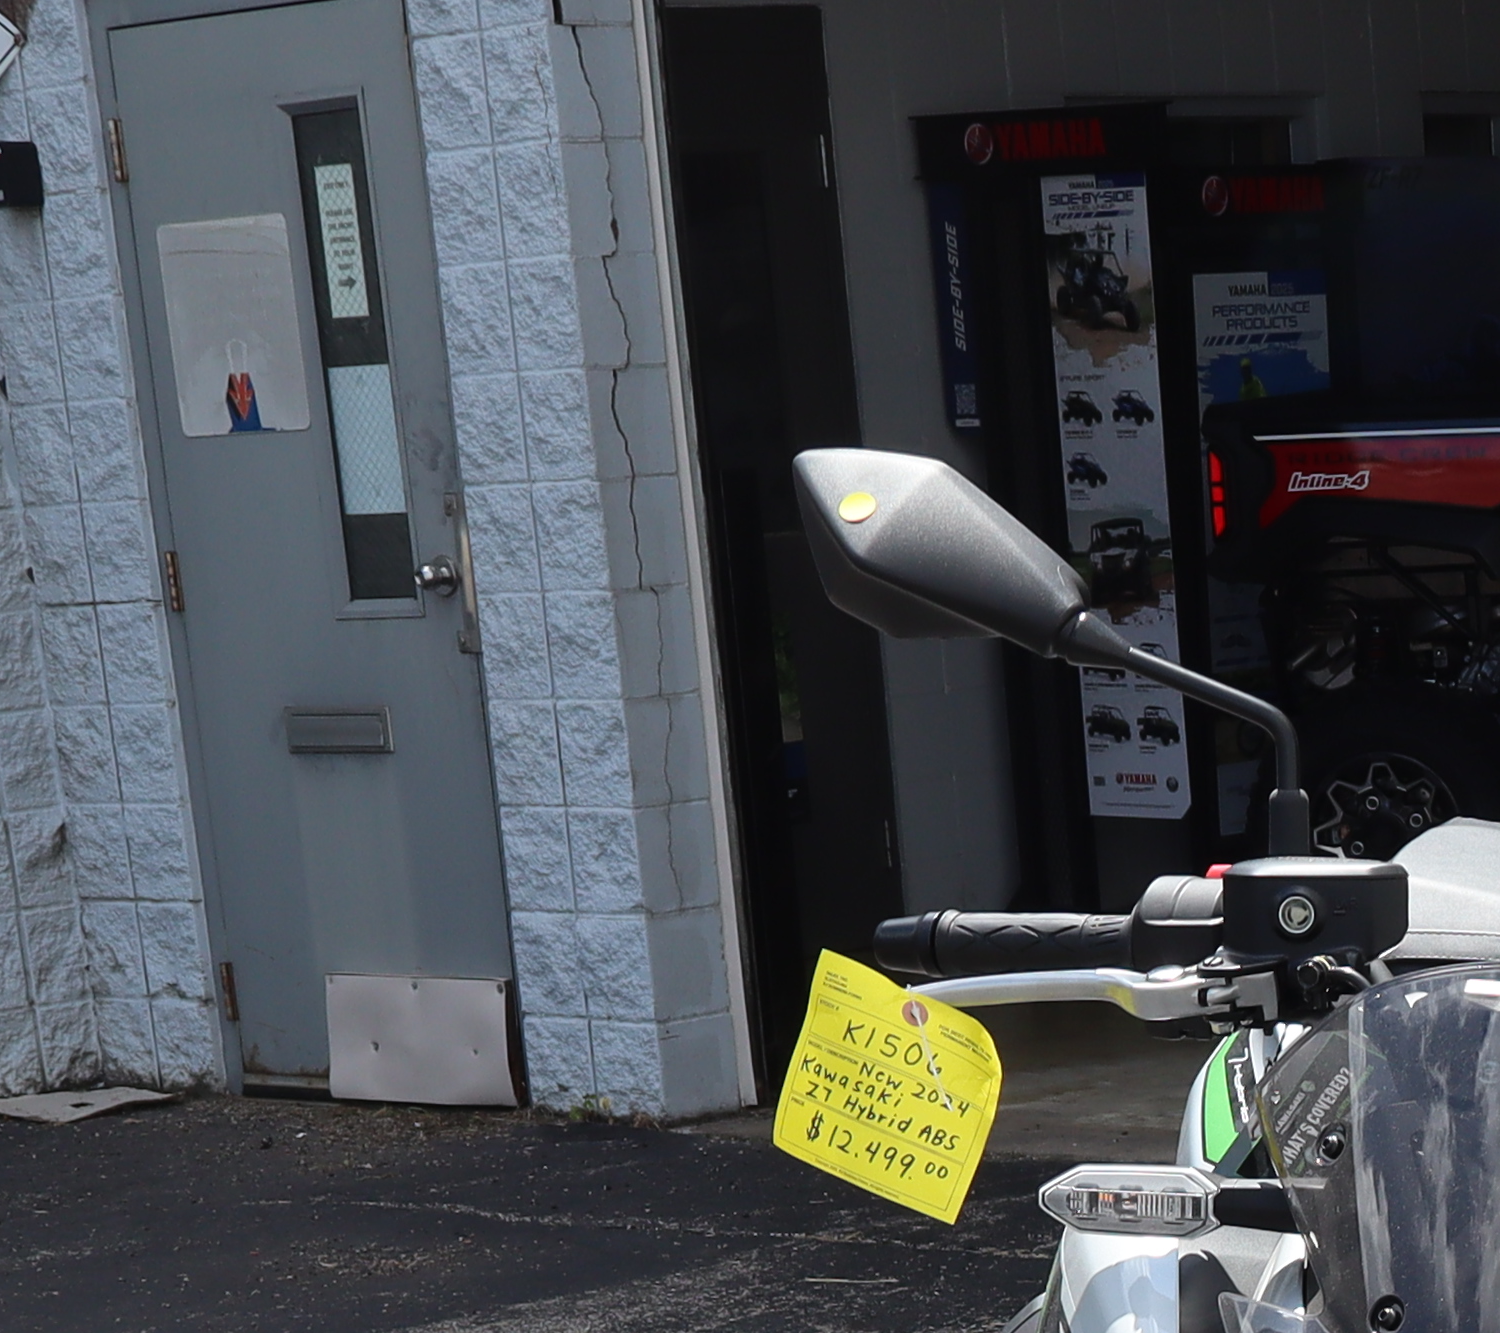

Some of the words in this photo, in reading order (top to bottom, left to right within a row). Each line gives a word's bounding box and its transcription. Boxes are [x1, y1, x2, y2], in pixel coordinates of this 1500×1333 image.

[994, 117, 1107, 162] YAMAHA
[1362, 165, 1423, 191] ZF-R7
[1049, 190, 1134, 206] SIDE-BY-SIDE
[1230, 175, 1325, 214] YAMAHA
[945, 221, 966, 352] SIDE-BY-SIDE
[1227, 284, 1267, 297] YAMAHA
[1212, 301, 1310, 318] PERFORMANCE
[1226, 316, 1298, 331] PRODUCTS
[1288, 470, 1370, 492] Inline-4
[1125, 774, 1157, 785] YAMAHA
[842, 1019, 942, 1077] K1506
[1228, 1047, 1249, 1064] 7
[800, 1053, 902, 1108] Kawasaki
[860, 1062, 903, 1091] New
[911, 1082, 970, 1118] 2024
[1306, 1067, 1352, 1128] COVERED?
[843, 1095, 913, 1134] Hybrid
[918, 1125, 960, 1151] ABS
